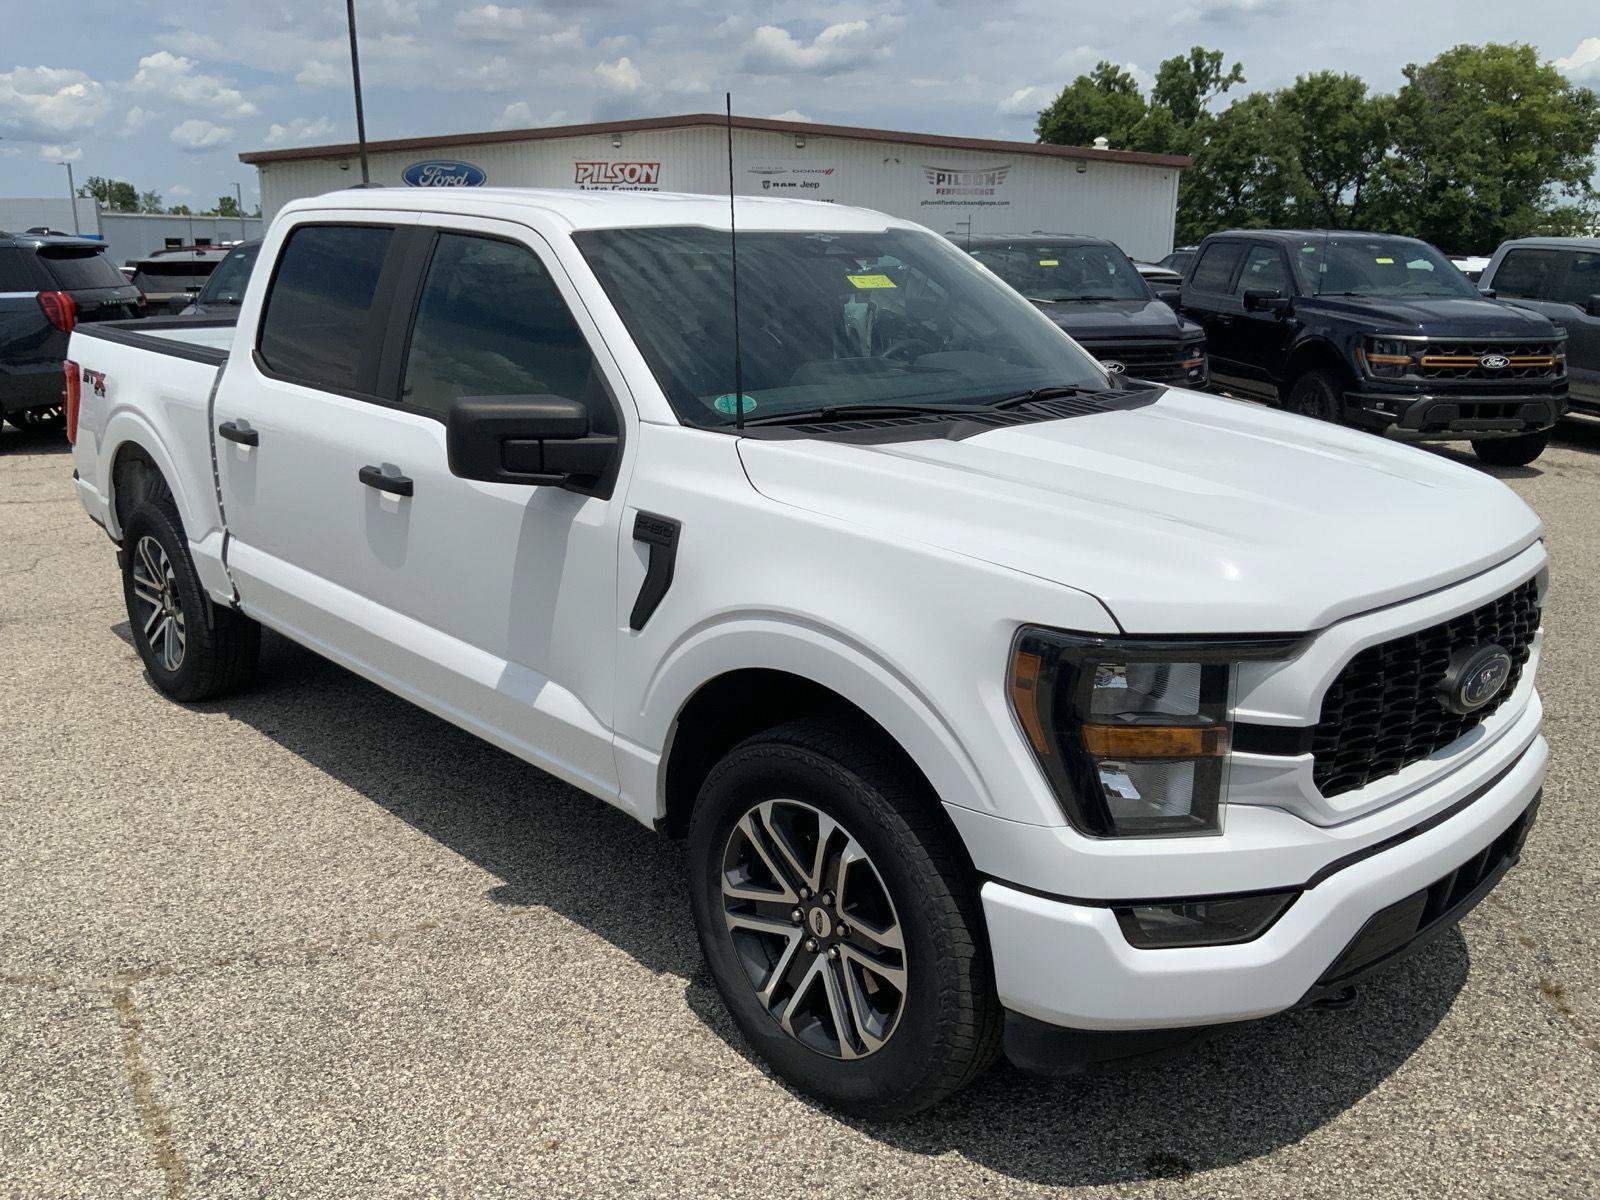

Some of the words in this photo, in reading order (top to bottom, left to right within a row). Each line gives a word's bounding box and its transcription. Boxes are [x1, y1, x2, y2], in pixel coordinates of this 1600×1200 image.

[418, 165, 470, 187] Ford
[574, 162, 660, 184] PILSON
[936, 172, 996, 186] PILSON
[800, 181, 820, 189] Jeep
[83, 367, 106, 391] STX
[1476, 665, 1504, 698] Ford
